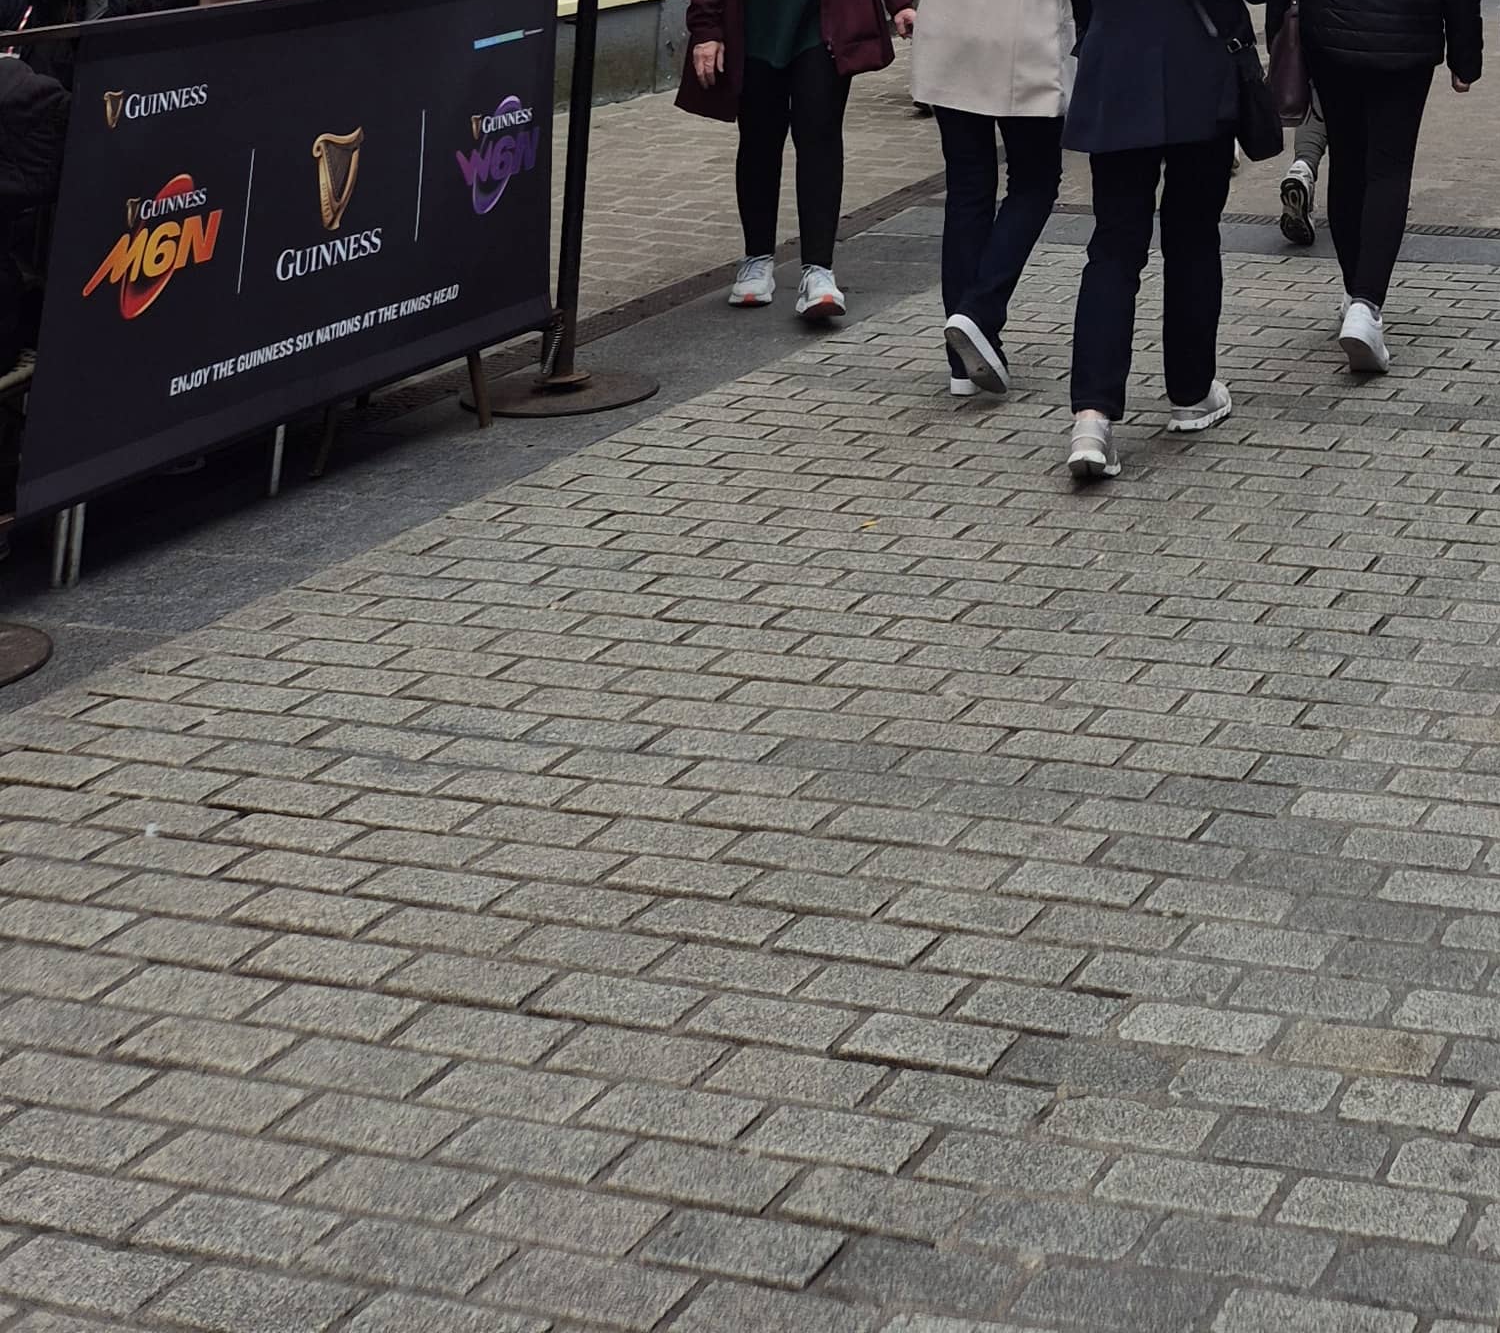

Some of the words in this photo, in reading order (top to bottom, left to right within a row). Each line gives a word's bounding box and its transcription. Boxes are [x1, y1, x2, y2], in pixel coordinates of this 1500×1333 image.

[125, 84, 209, 119] GUINNESS
[482, 107, 534, 134] GUINNESS
[456, 126, 541, 186] W6N
[140, 187, 208, 221] GUINNESS
[82, 208, 223, 297] M6N
[275, 227, 383, 282] GUINNESS
[169, 364, 212, 397] ENJOY
[212, 358, 236, 382] THE
[236, 336, 294, 374] GUINNESS
[295, 331, 315, 353] SIX
[315, 315, 362, 346] NATIONS
[361, 309, 378, 329] AT
[377, 302, 400, 325] THE
[399, 294, 432, 318] KINGS
[431, 284, 461, 306] HEAD
